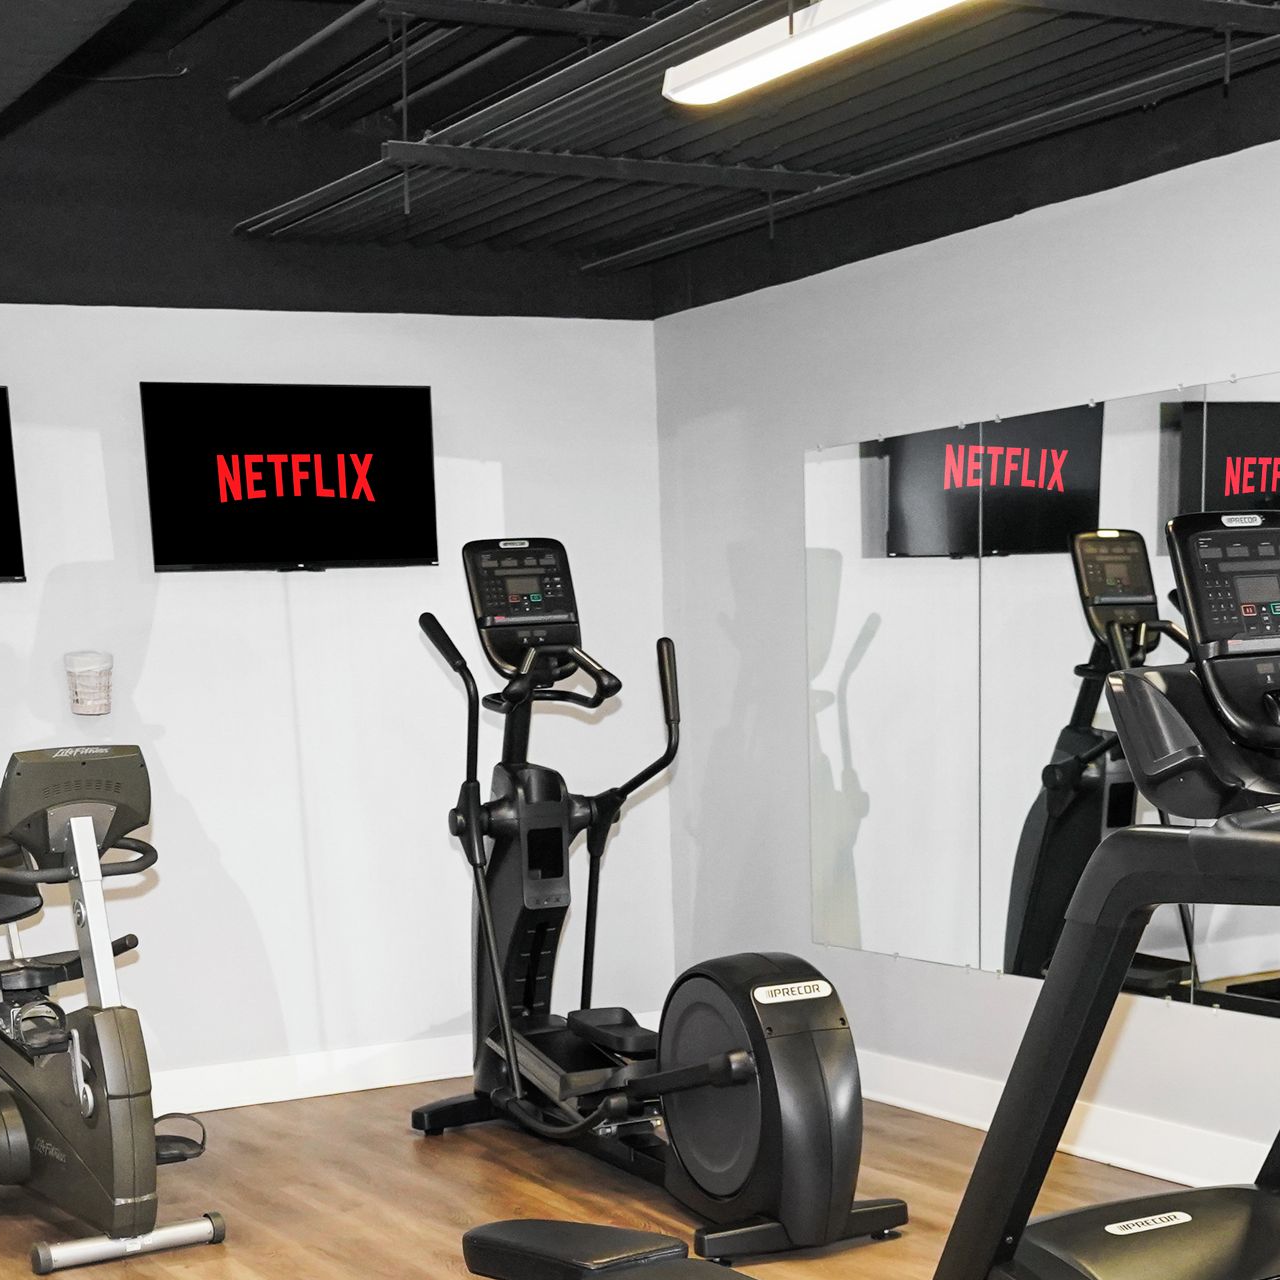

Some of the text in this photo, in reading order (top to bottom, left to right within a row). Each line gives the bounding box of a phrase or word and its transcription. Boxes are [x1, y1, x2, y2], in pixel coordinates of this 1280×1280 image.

[216, 453, 376, 504] NETFLIX
[943, 443, 1069, 493] NETFLIX
[773, 983, 821, 998] PRECOR
[1126, 1214, 1180, 1231] PRECOR
